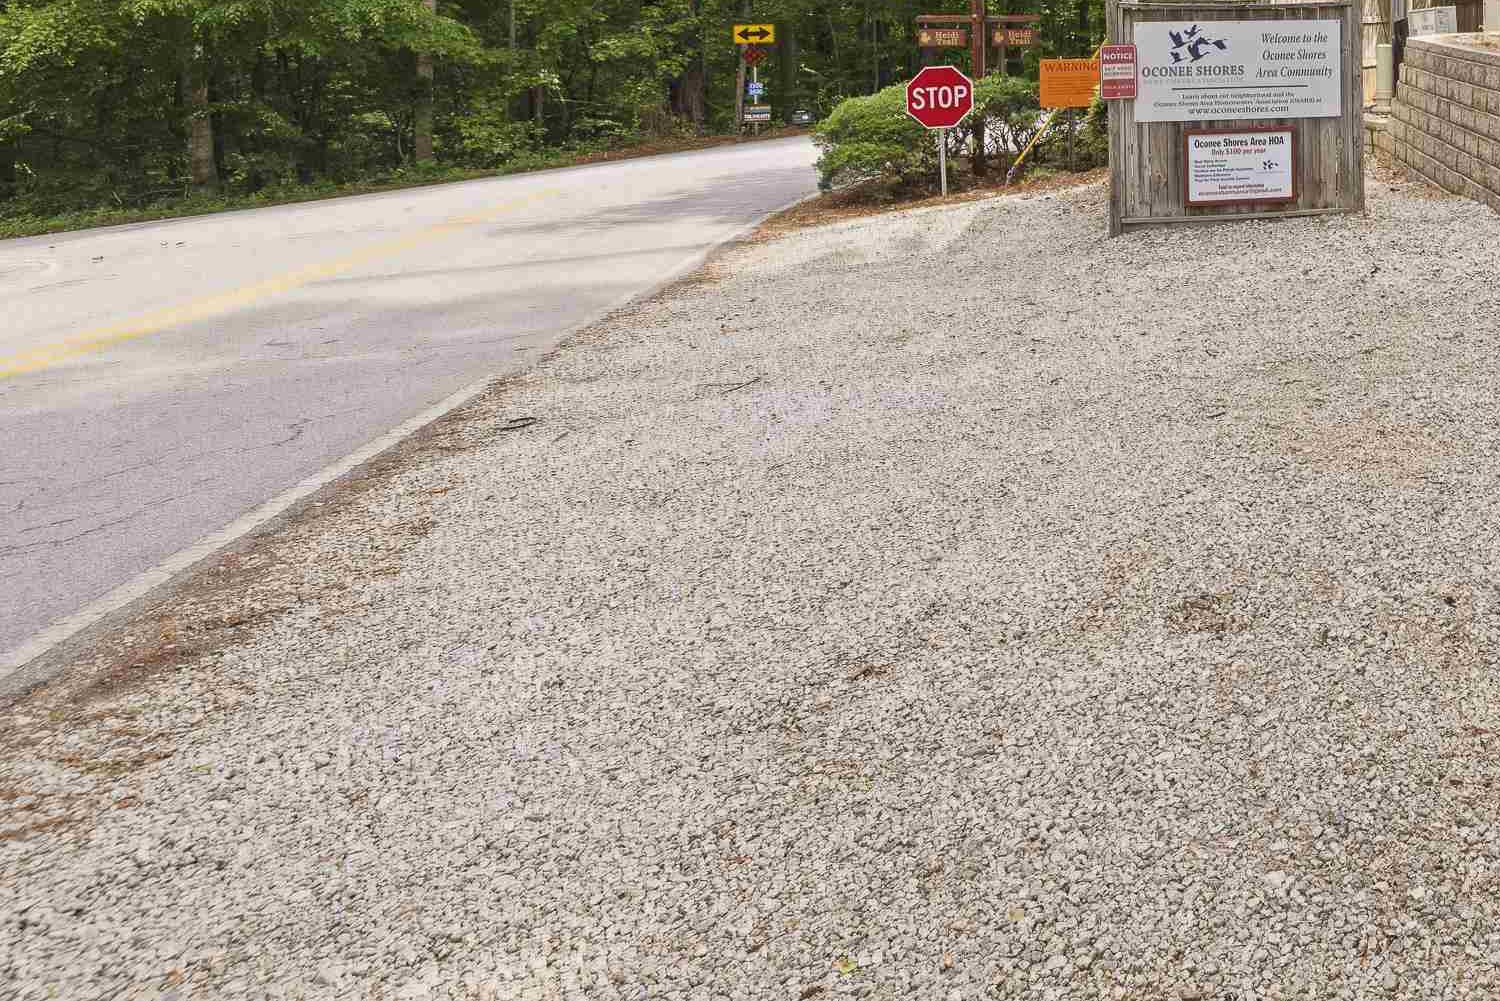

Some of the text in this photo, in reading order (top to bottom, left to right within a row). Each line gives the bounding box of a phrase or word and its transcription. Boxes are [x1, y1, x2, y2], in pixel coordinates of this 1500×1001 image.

[1261, 32, 1328, 43] Welcome to the
[1262, 50, 1327, 61] Oconee Shores
[1044, 62, 1098, 72] WARNING
[1142, 66, 1193, 78] OCONEE
[1195, 64, 1245, 76] SHORES
[1256, 66, 1333, 79] Area Community
[911, 85, 968, 111] STOP
[1188, 106, 1289, 115] www.oconeeshores.com
[1194, 136, 1284, 148] Oconee Shores Area HOA
